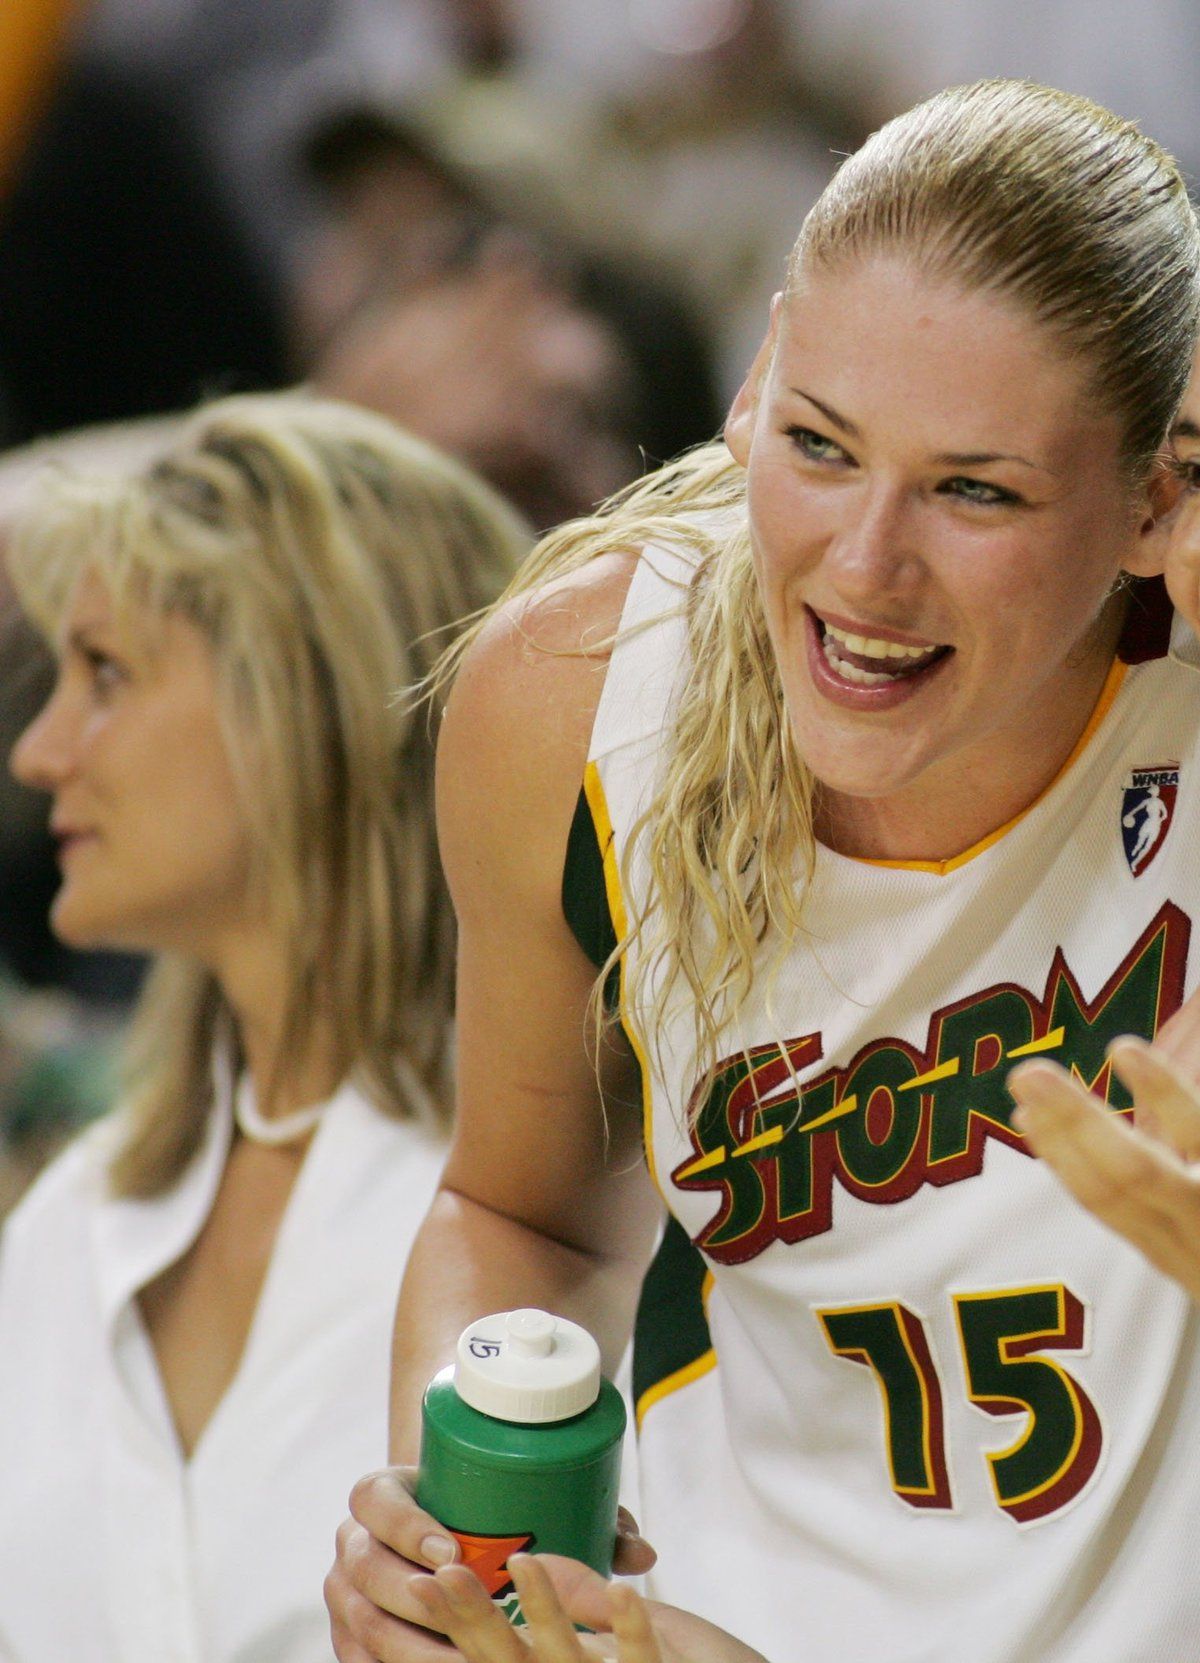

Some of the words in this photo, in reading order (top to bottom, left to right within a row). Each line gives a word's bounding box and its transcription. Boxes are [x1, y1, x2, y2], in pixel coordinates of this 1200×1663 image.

[1132, 771, 1179, 787] WNBA
[671, 898, 1192, 1266] STORM
[469, 1336, 502, 1358] 15
[814, 1283, 1105, 1525] 15
